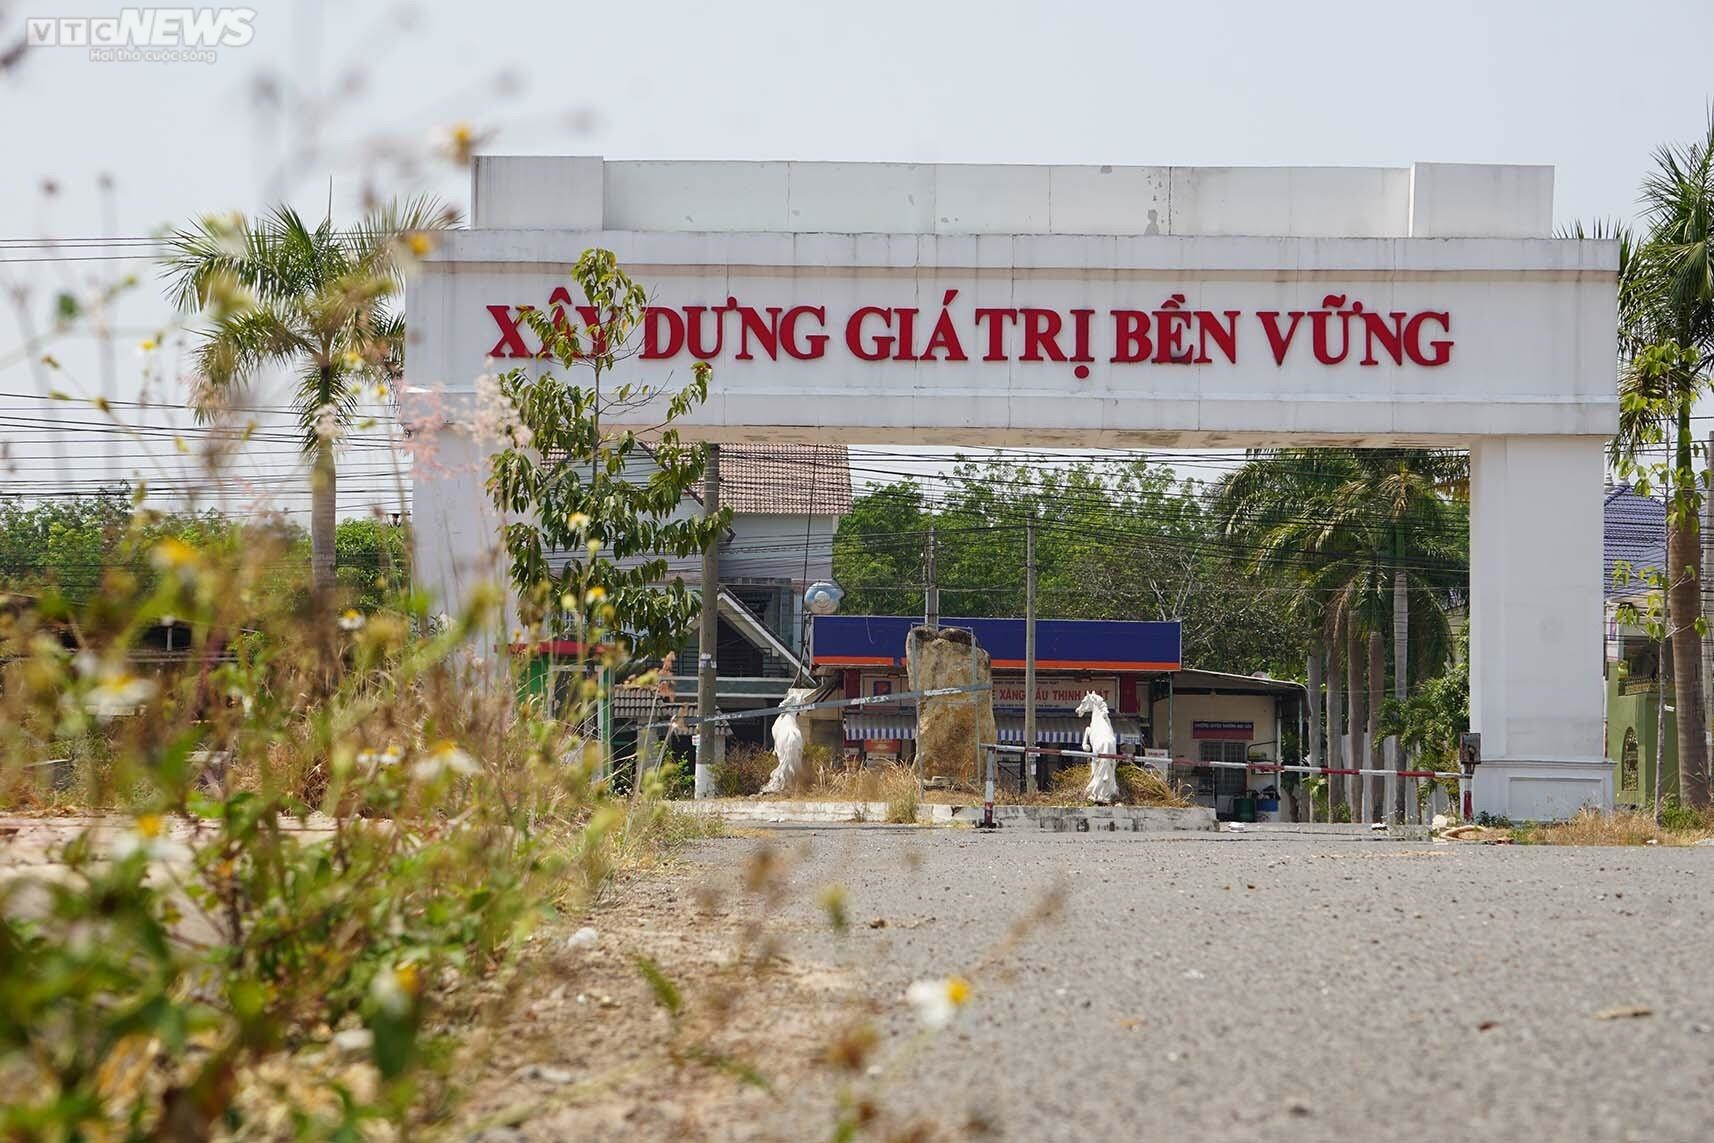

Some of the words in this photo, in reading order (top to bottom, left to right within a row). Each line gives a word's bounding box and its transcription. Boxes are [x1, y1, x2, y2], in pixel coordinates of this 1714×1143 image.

[486, 286, 623, 359] XÂY
[845, 289, 969, 361] GIÁ
[975, 308, 1096, 379] TRỊ
[1110, 294, 1241, 364] BỀN
[1256, 294, 1454, 366] VỮNG
